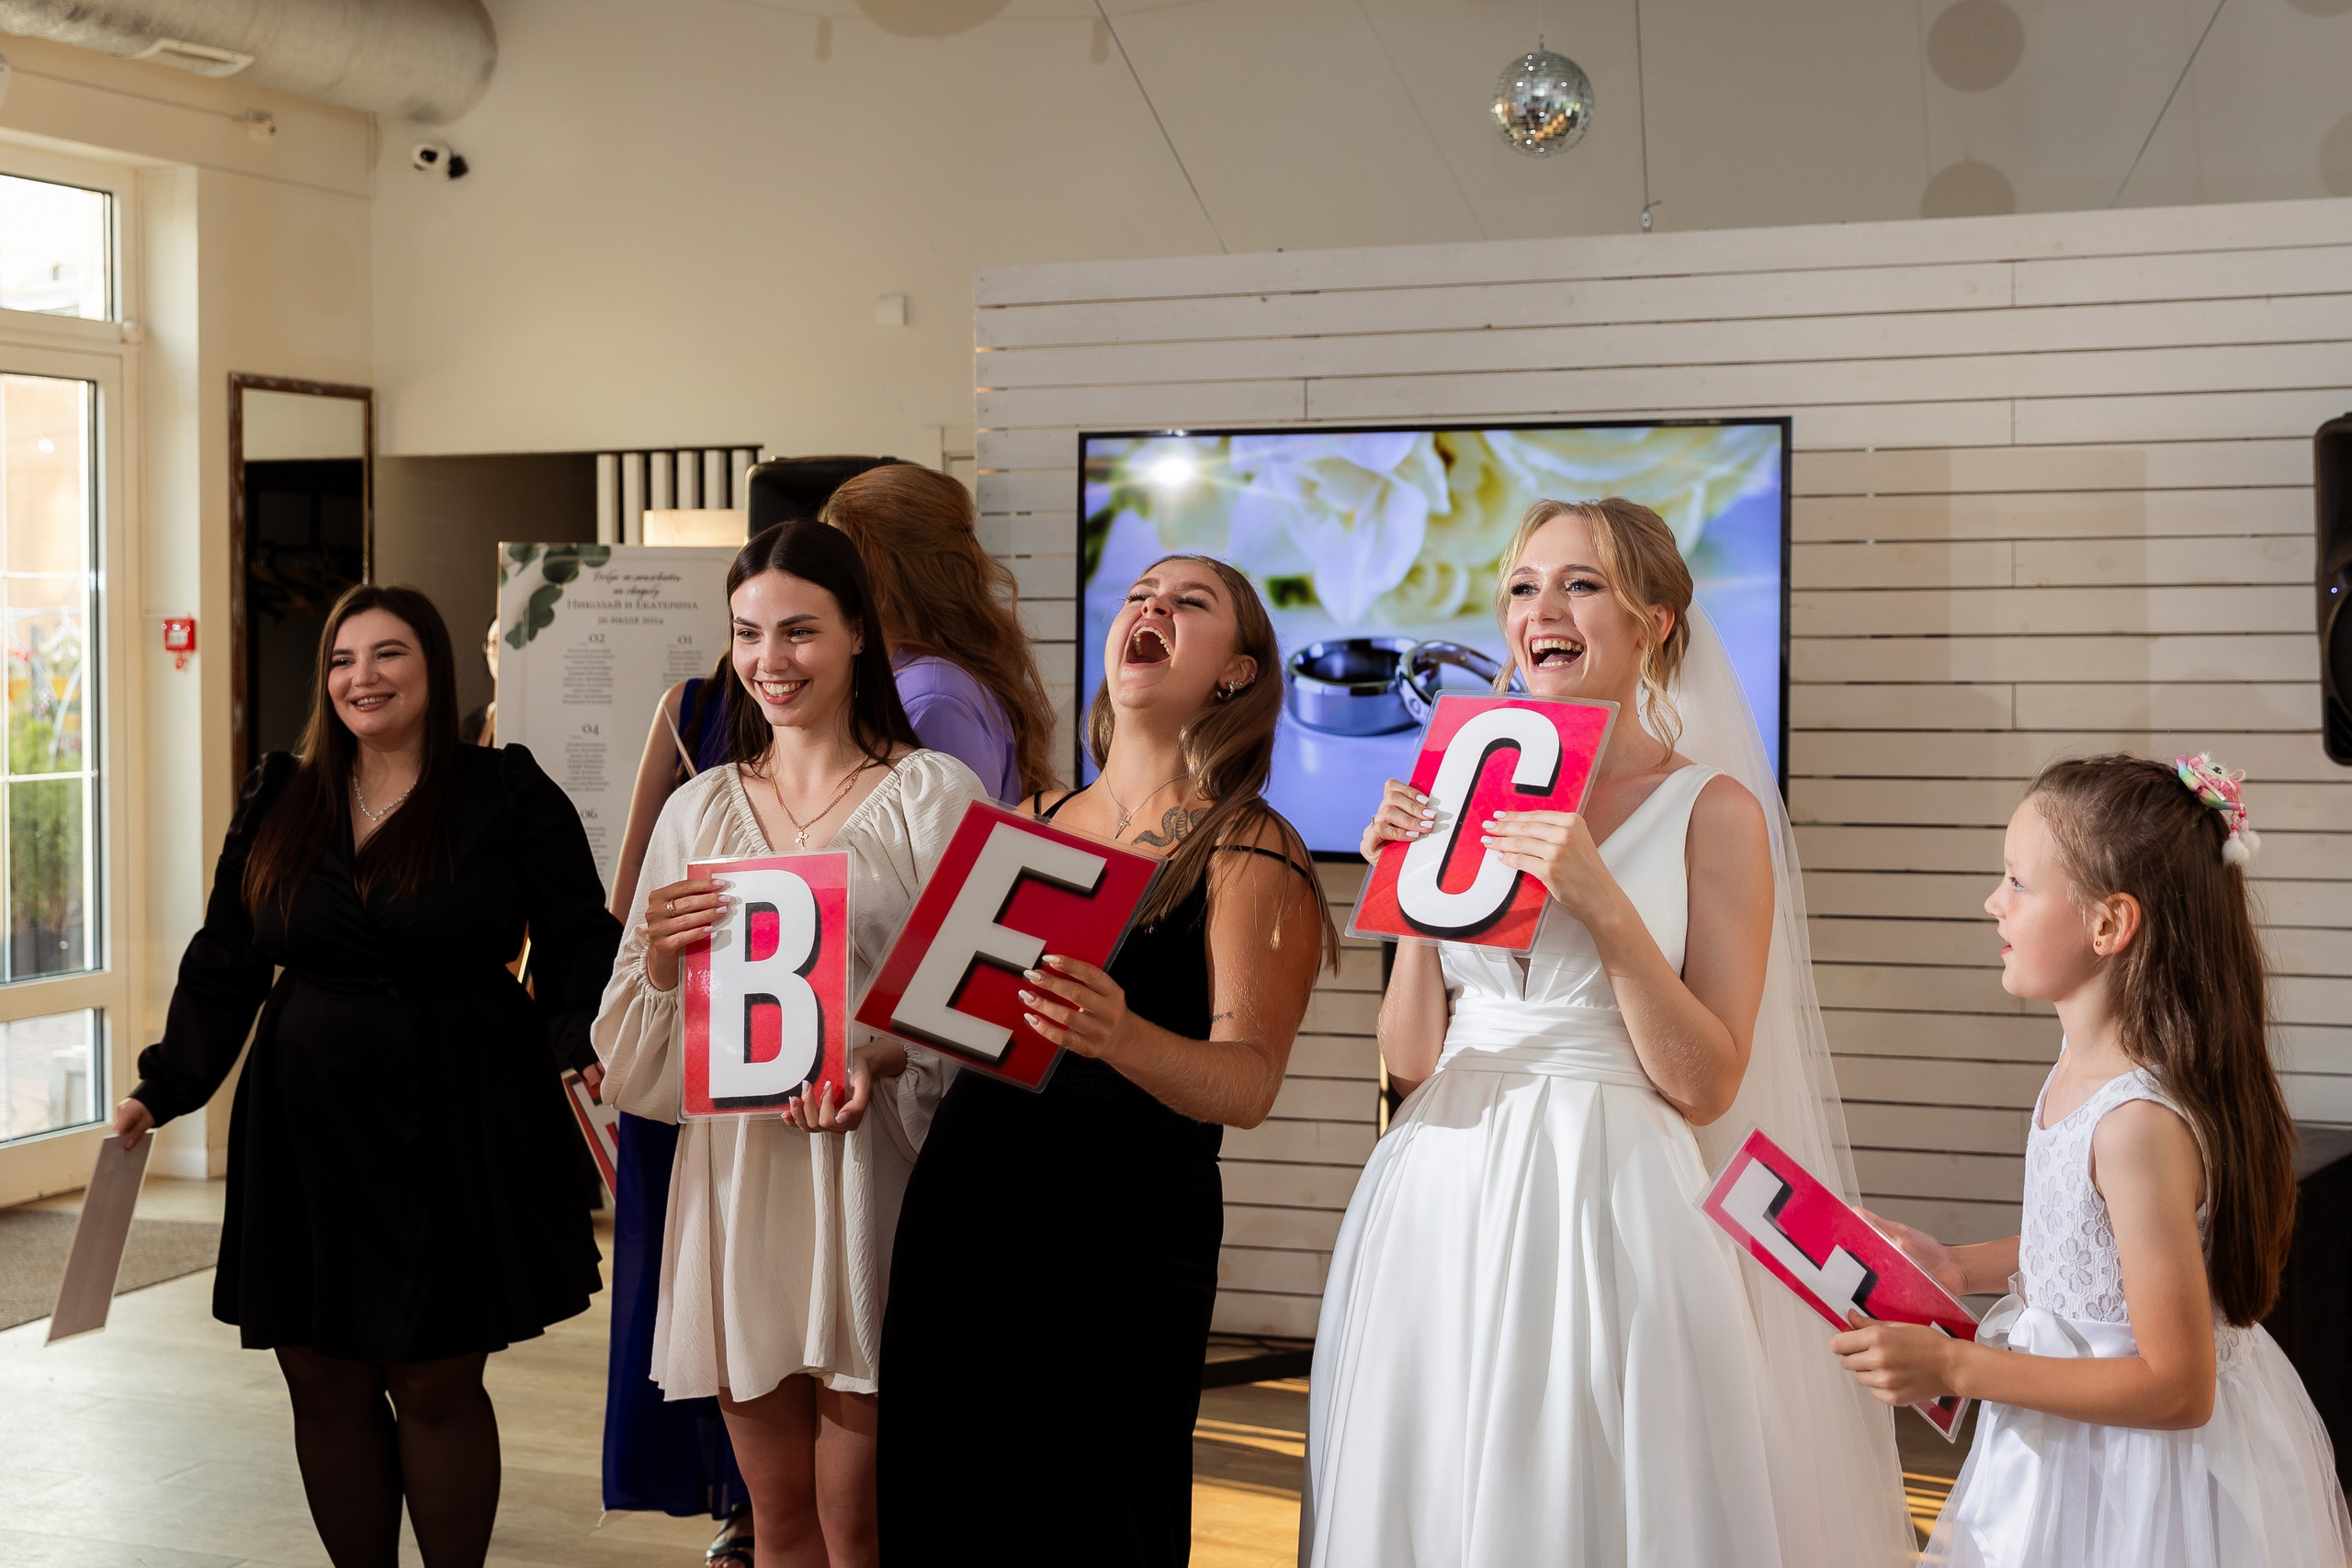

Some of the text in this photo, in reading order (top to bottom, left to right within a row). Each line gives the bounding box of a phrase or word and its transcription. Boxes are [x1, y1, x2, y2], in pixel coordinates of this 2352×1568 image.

[588, 632, 606, 644] 02
[582, 723, 599, 736] 04
[581, 808, 598, 820] 06
